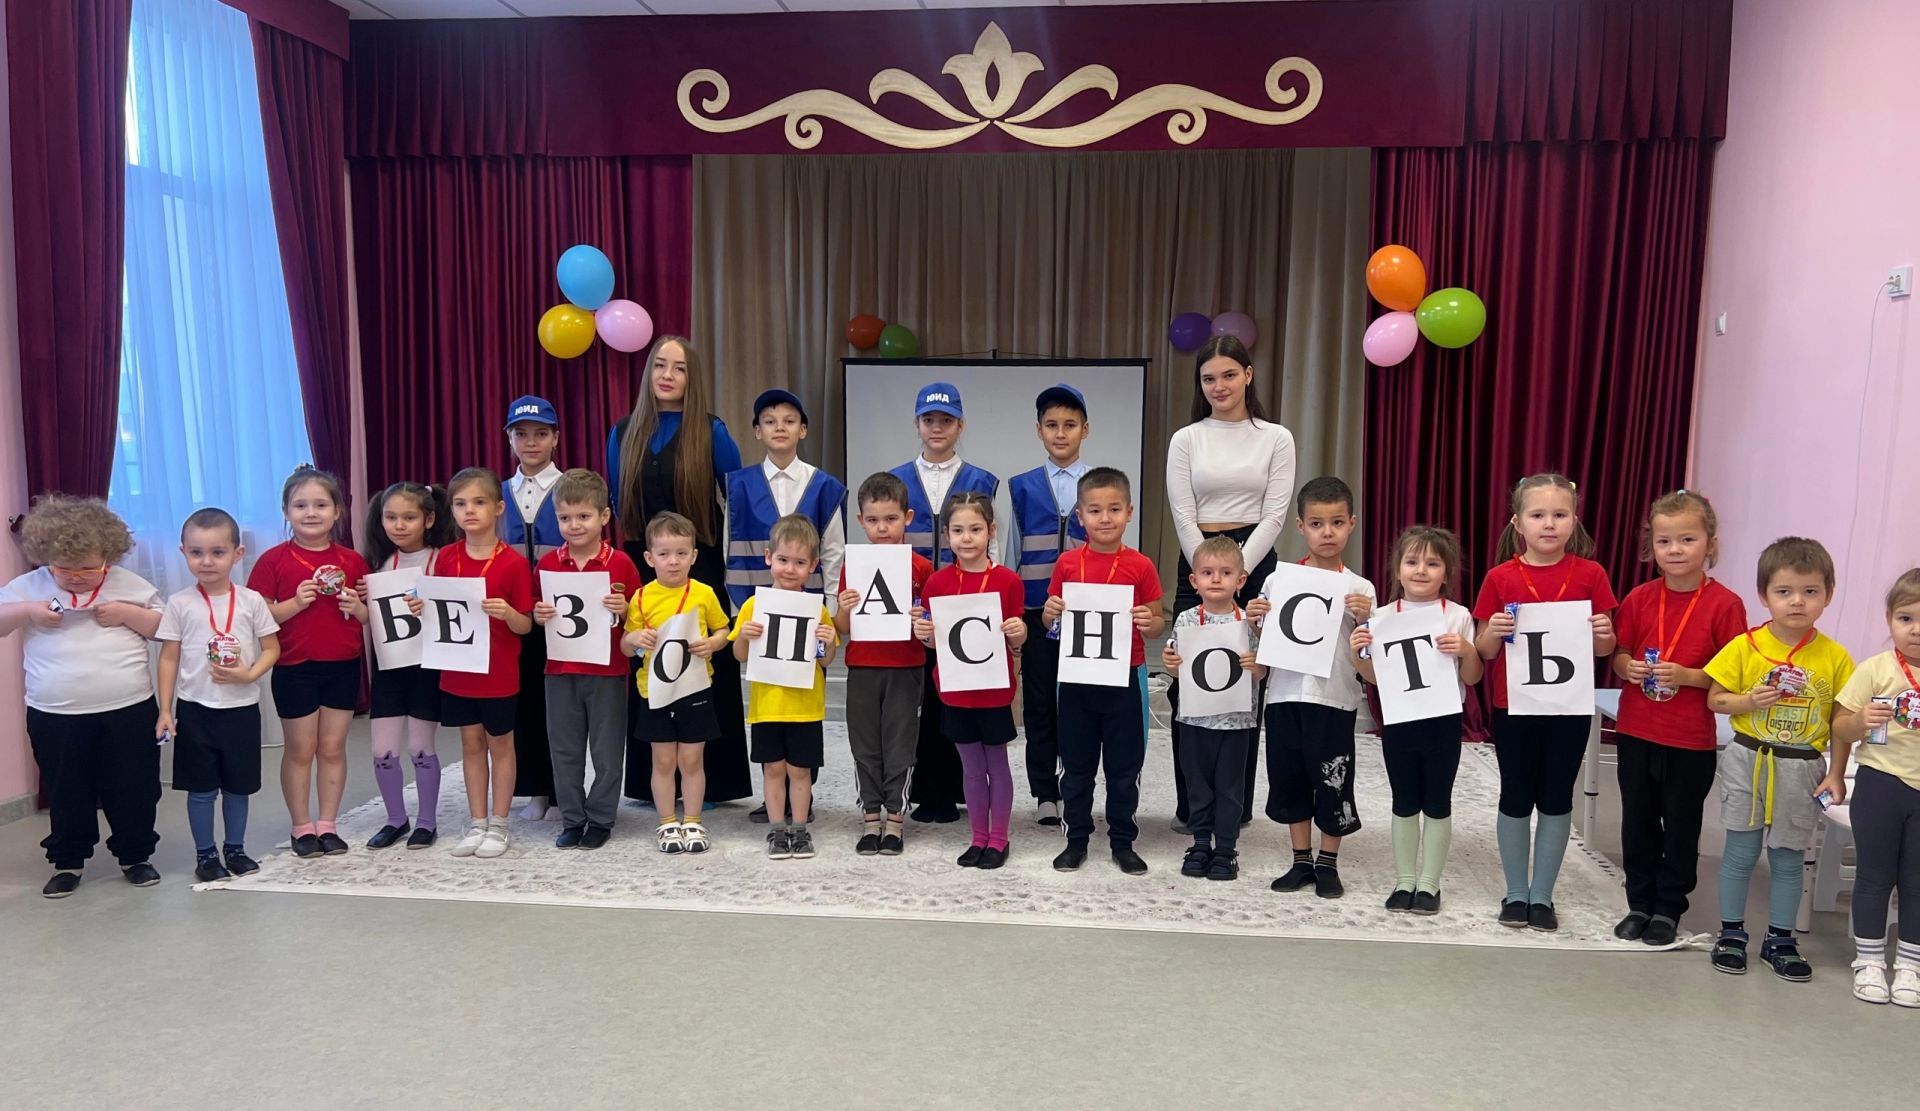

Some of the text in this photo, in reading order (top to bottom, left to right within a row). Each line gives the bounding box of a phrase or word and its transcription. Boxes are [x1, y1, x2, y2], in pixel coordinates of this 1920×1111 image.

[515, 405, 539, 415] ЮИД
[926, 393, 949, 403] ЮИД
[855, 568, 904, 615] А
[372, 593, 422, 644] Б
[428, 598, 475, 645] Е
[553, 594, 589, 639] З
[759, 612, 815, 663] П
[948, 615, 994, 665] С
[1066, 610, 1120, 660] Н
[1279, 592, 1333, 646] С
[653, 639, 692, 683] О
[1191, 647, 1244, 693] О
[1383, 634, 1433, 692] Т
[1518, 631, 1575, 686] Ь
[1769, 719, 1805, 732] DISTRICT
[1775, 707, 1806, 720] EAST
